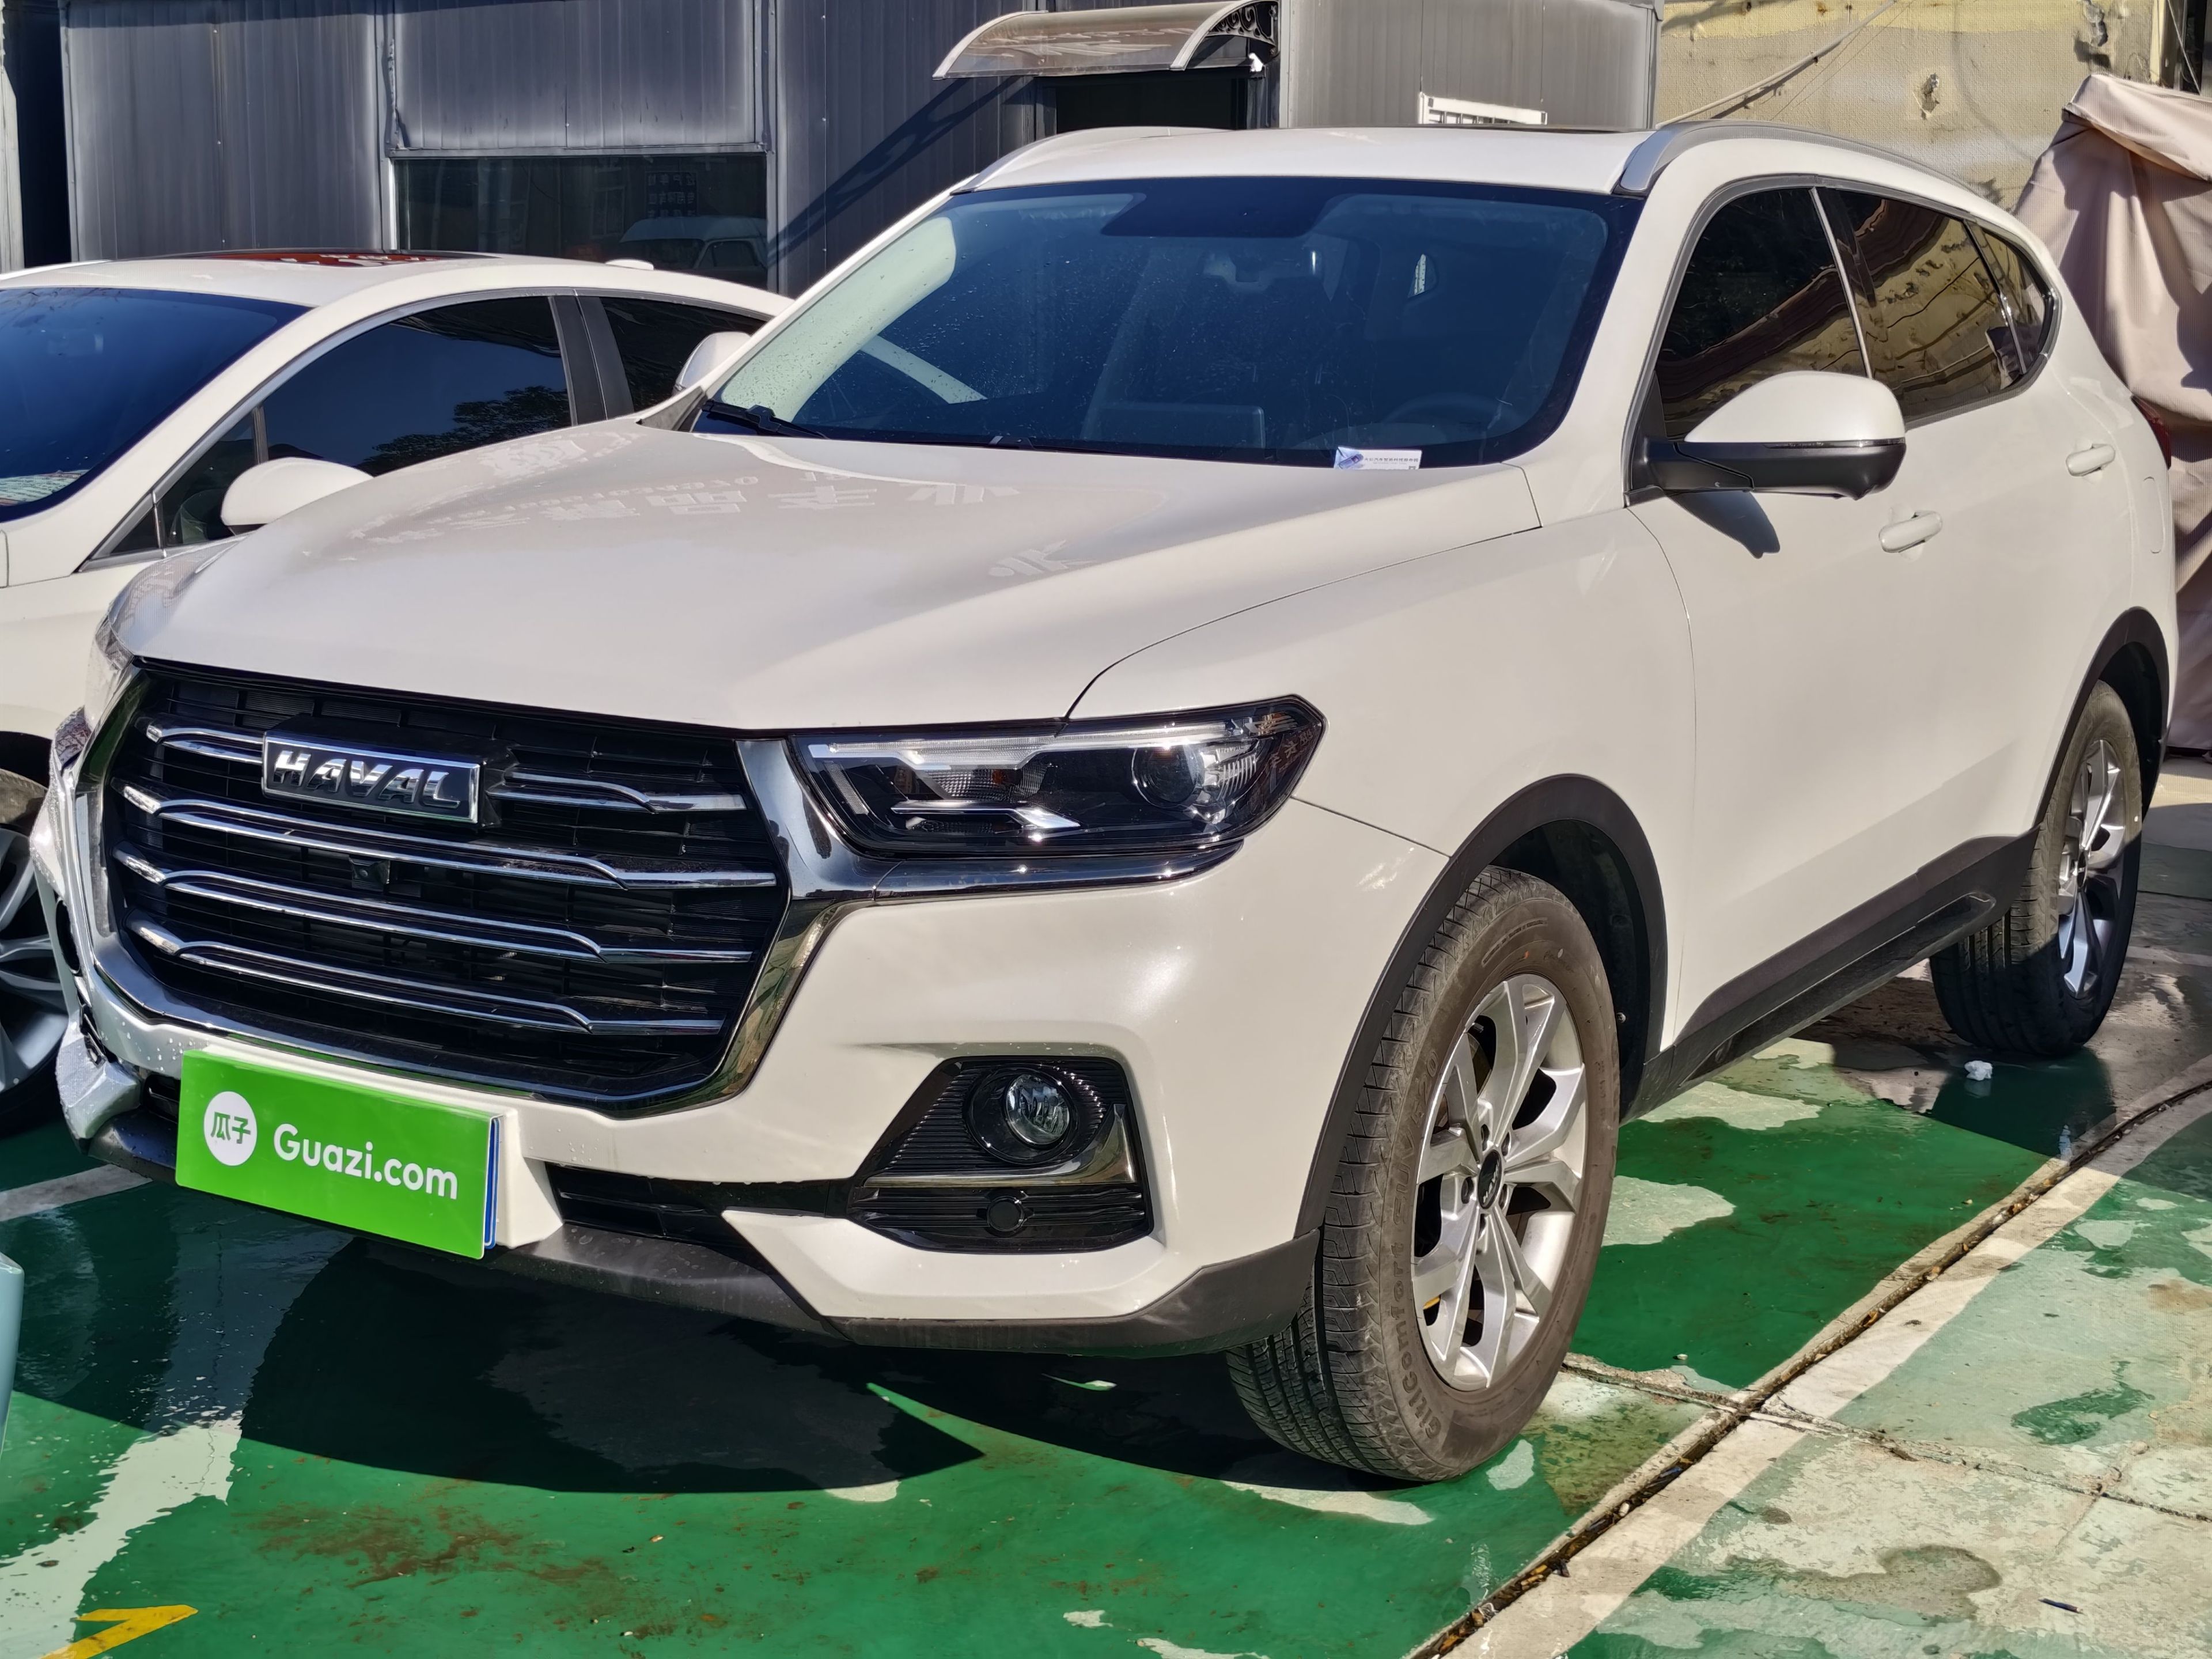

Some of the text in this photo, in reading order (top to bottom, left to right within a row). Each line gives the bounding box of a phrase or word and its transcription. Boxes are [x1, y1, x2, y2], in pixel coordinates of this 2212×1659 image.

[272, 749, 461, 809] HAVAL
[210, 1111, 251, 1145] 瓜子
[273, 1123, 458, 1200] Guazi.com
